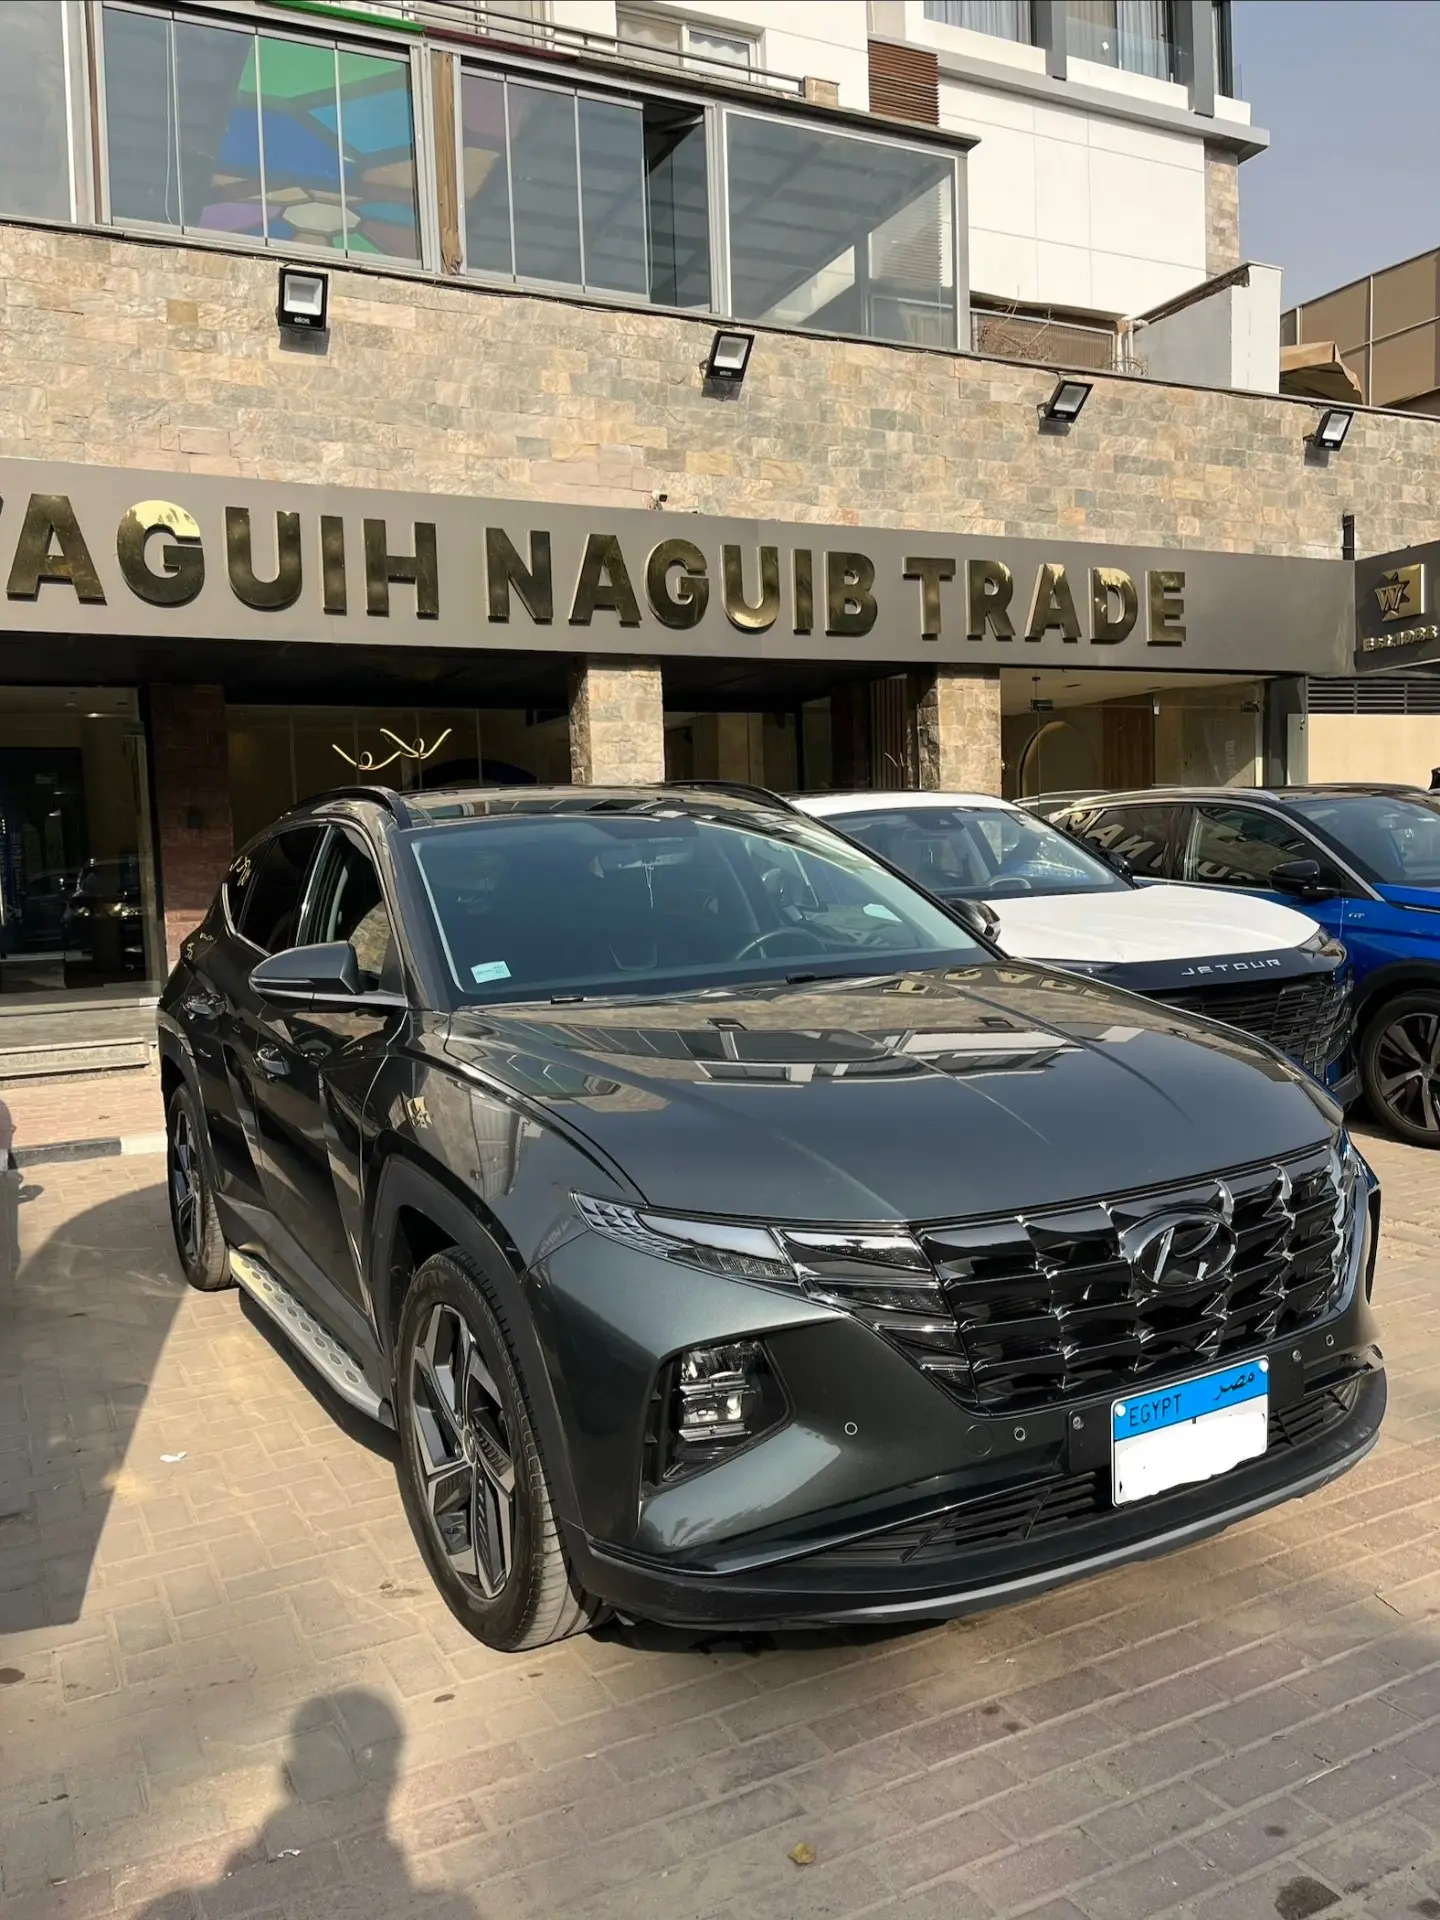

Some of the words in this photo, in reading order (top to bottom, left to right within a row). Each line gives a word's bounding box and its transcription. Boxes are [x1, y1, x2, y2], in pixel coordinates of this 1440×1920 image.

[0, 492, 439, 620] AGUIH
[485, 526, 878, 637] NAGUIB
[902, 556, 1188, 647] TRADE
[1181, 958, 1282, 976] JETOUR
[1213, 1372, 1256, 1401] مصر
[1129, 1393, 1183, 1428] EGYPT
